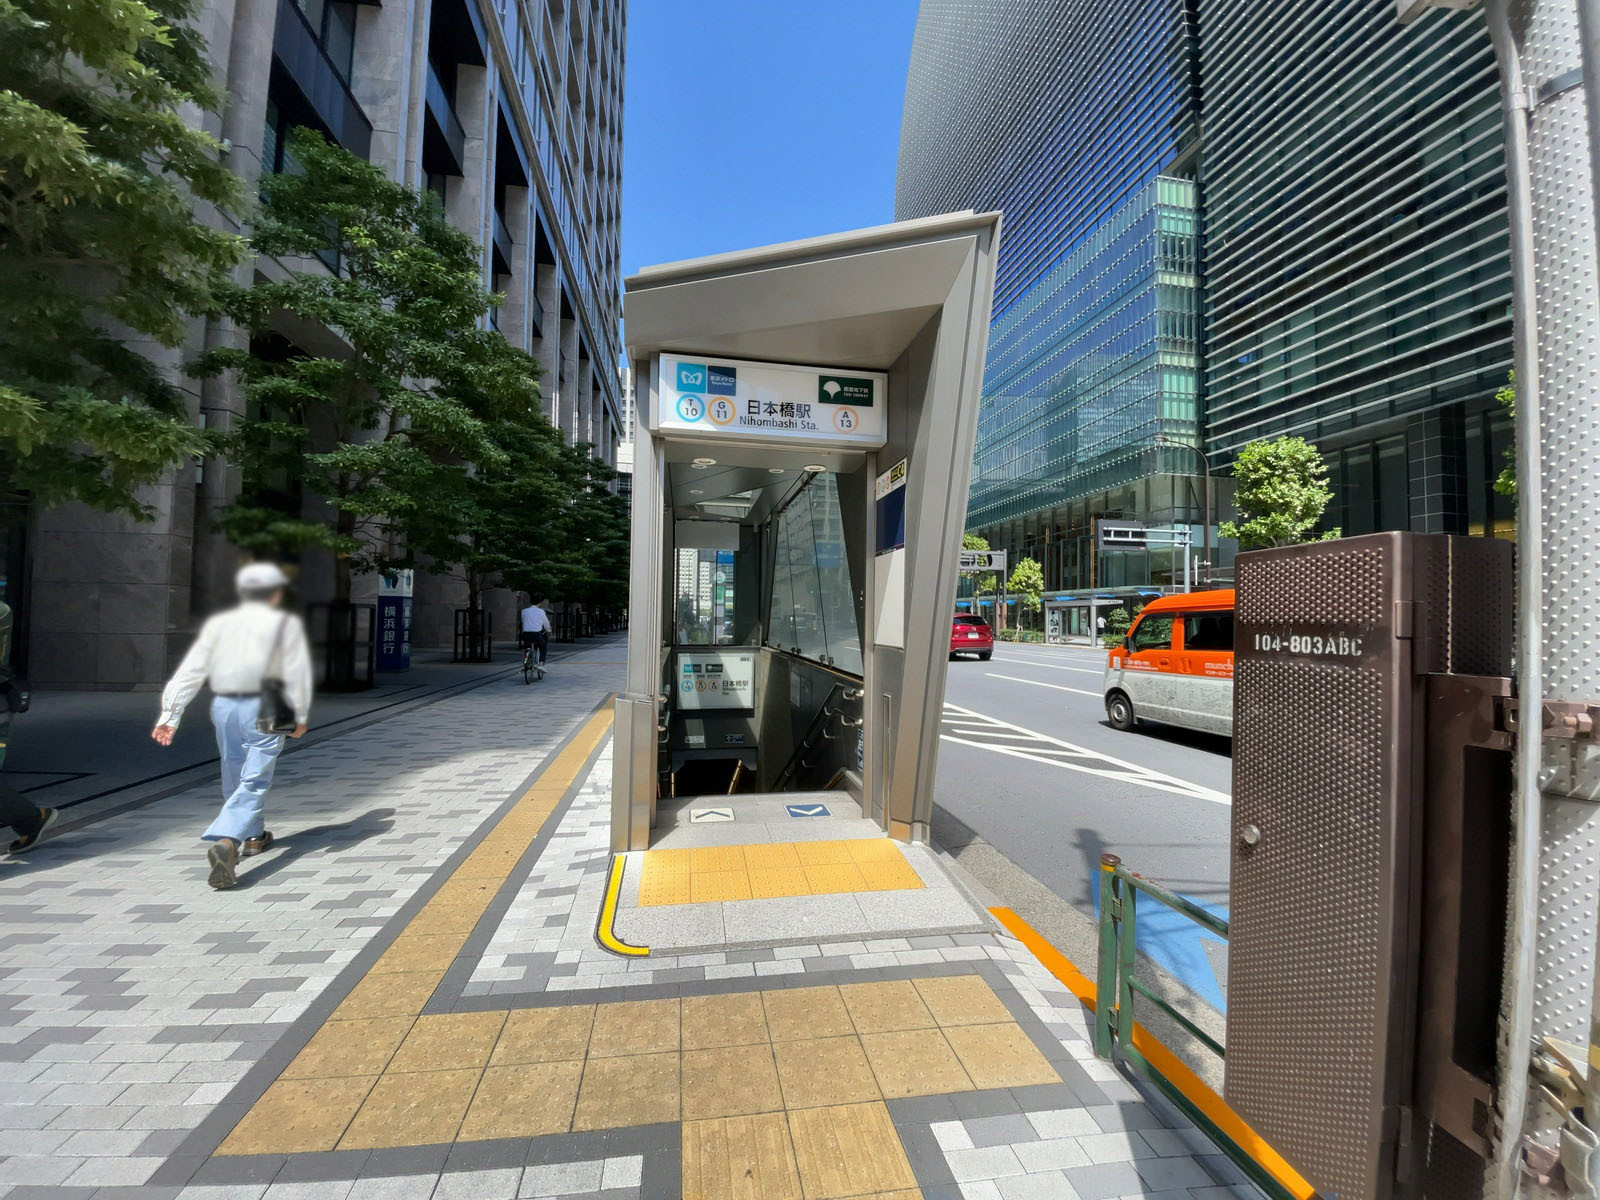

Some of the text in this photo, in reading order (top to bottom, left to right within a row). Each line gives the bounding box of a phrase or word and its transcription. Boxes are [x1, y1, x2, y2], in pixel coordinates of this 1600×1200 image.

[688, 399, 694, 407] T
[718, 401, 726, 410] G
[685, 407, 698, 417] 10
[747, 399, 811, 419] 日本橋駅
[716, 410, 727, 419] 11
[842, 411, 849, 419] A
[739, 415, 819, 430] Nihombashi Sta.
[840, 419, 852, 428] 13
[383, 606, 396, 654] 横浜銀行
[1255, 634, 1362, 656] 104-803ABC
